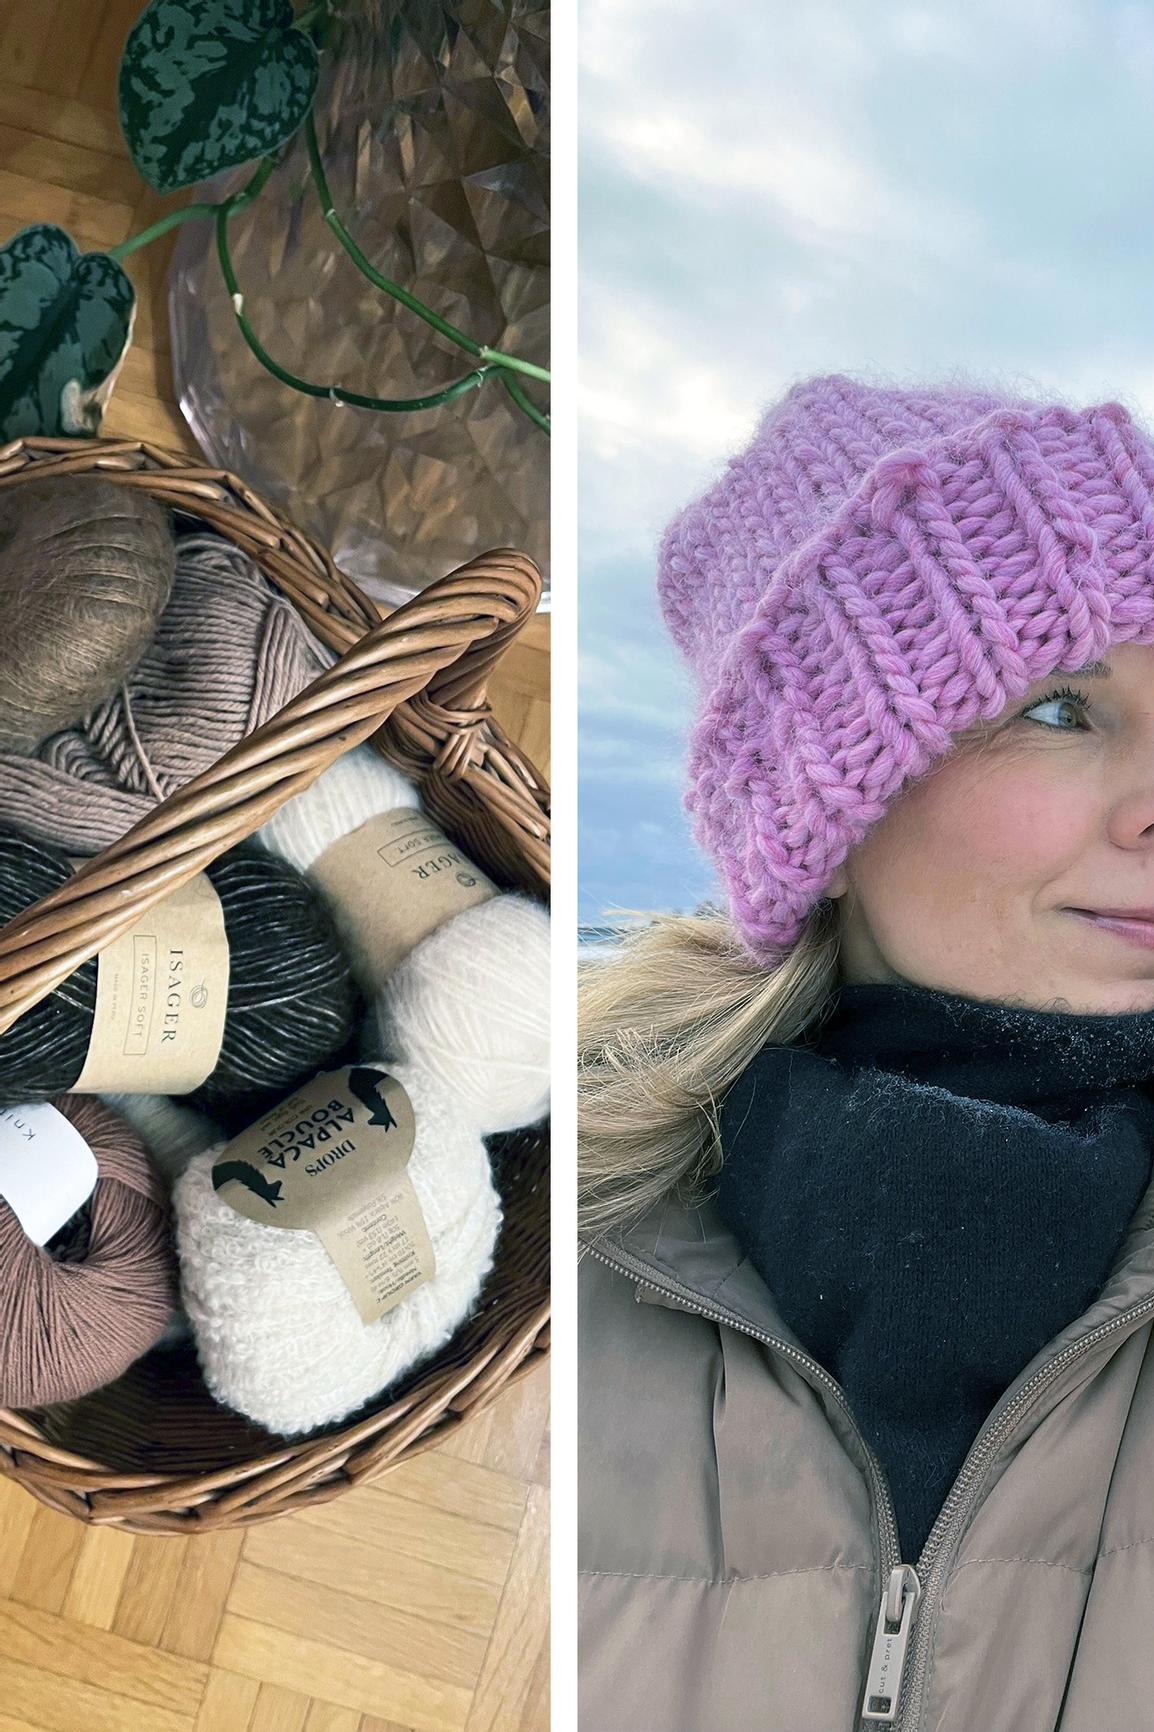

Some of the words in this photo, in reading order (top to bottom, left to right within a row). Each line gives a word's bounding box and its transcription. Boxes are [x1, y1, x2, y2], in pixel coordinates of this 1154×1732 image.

[412, 854, 464, 879] AGER
[139, 953, 150, 1000] ISAGER
[161, 950, 184, 1043] ISAGER
[132, 1006, 146, 1037] SOFT
[267, 1107, 354, 1169] ALPACA
[305, 1140, 356, 1177] DROPS
